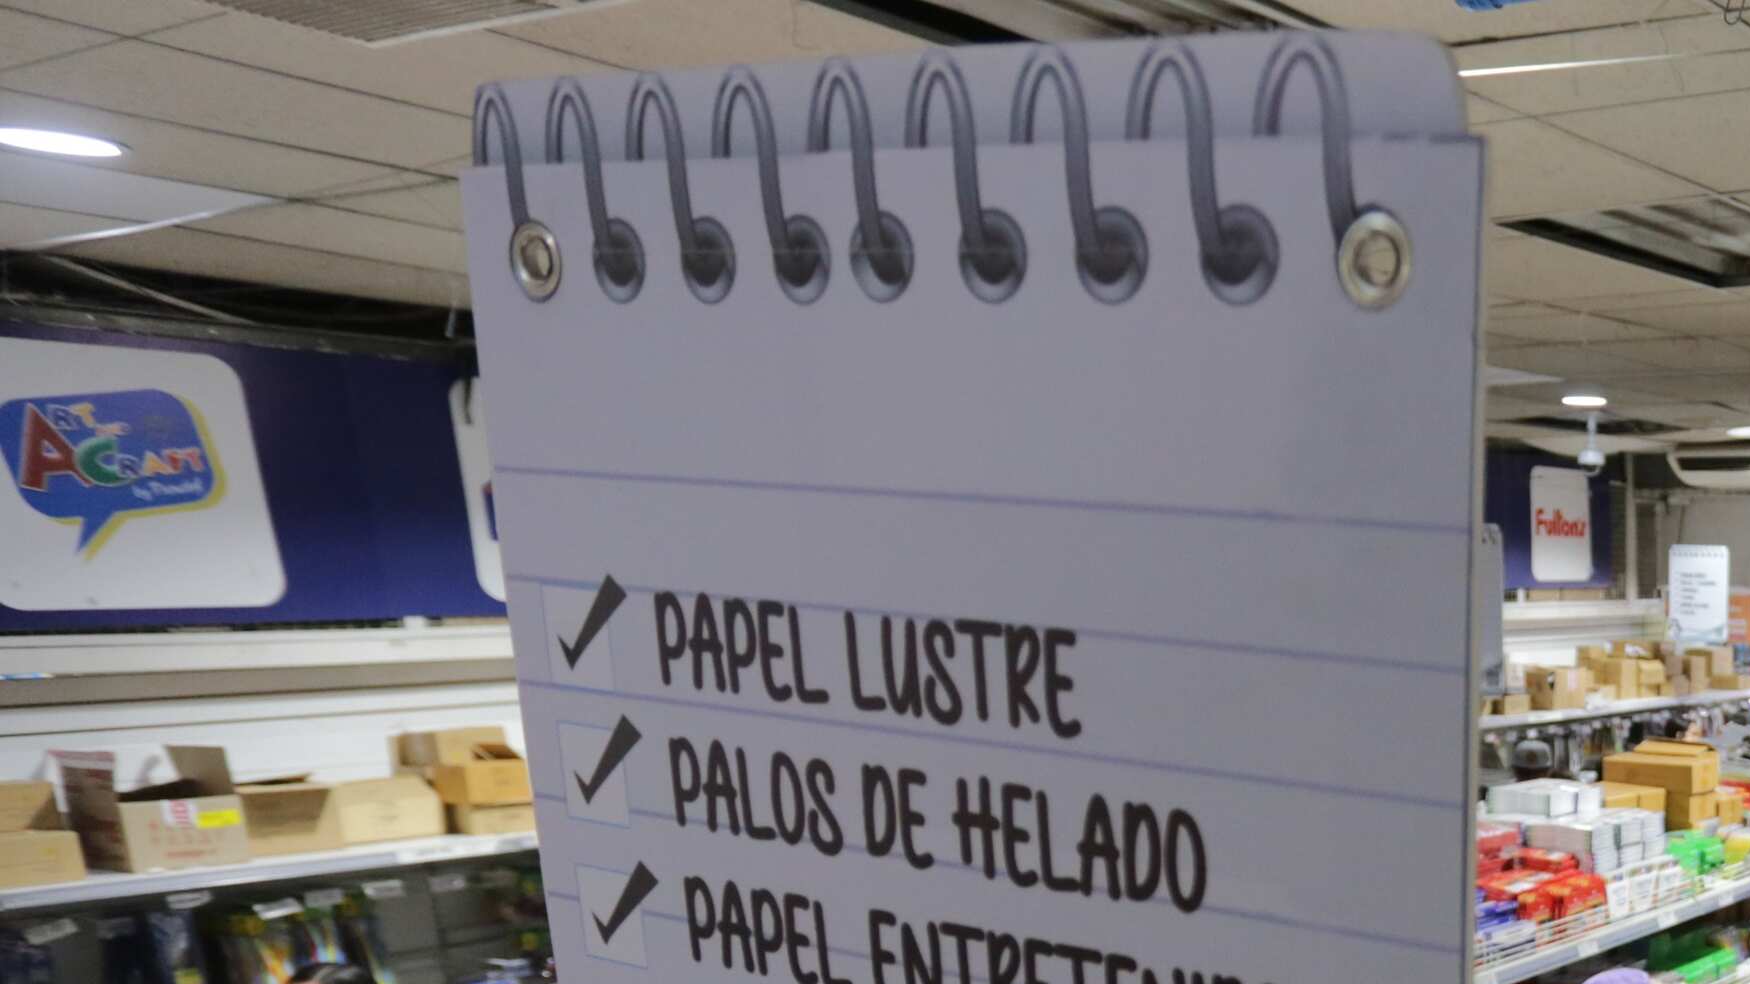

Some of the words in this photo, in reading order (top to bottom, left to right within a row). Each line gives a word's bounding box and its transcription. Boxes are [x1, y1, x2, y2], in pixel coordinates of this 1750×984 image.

[653, 591, 829, 705] PAPEL
[845, 610, 1082, 739] LUSTRE
[669, 737, 843, 857] PALOS
[861, 762, 934, 869] DE
[952, 776, 1206, 913] HELADO
